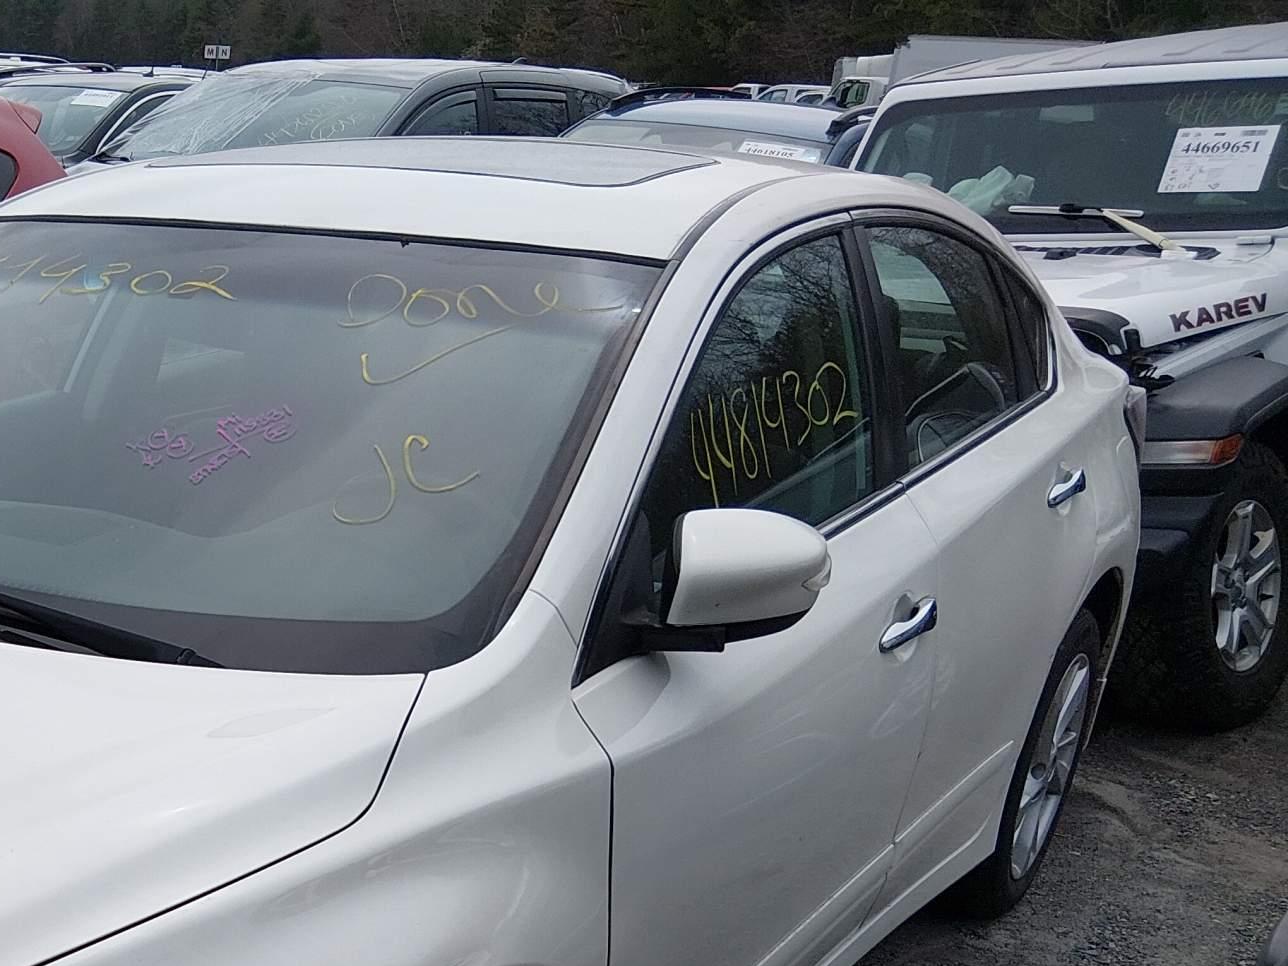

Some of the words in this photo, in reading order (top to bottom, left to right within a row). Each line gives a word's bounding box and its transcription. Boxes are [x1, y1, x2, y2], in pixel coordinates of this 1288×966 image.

[1181, 141, 1260, 154] 44669651
[1169, 293, 1267, 333] KAREV
[691, 361, 858, 508] 44814302
